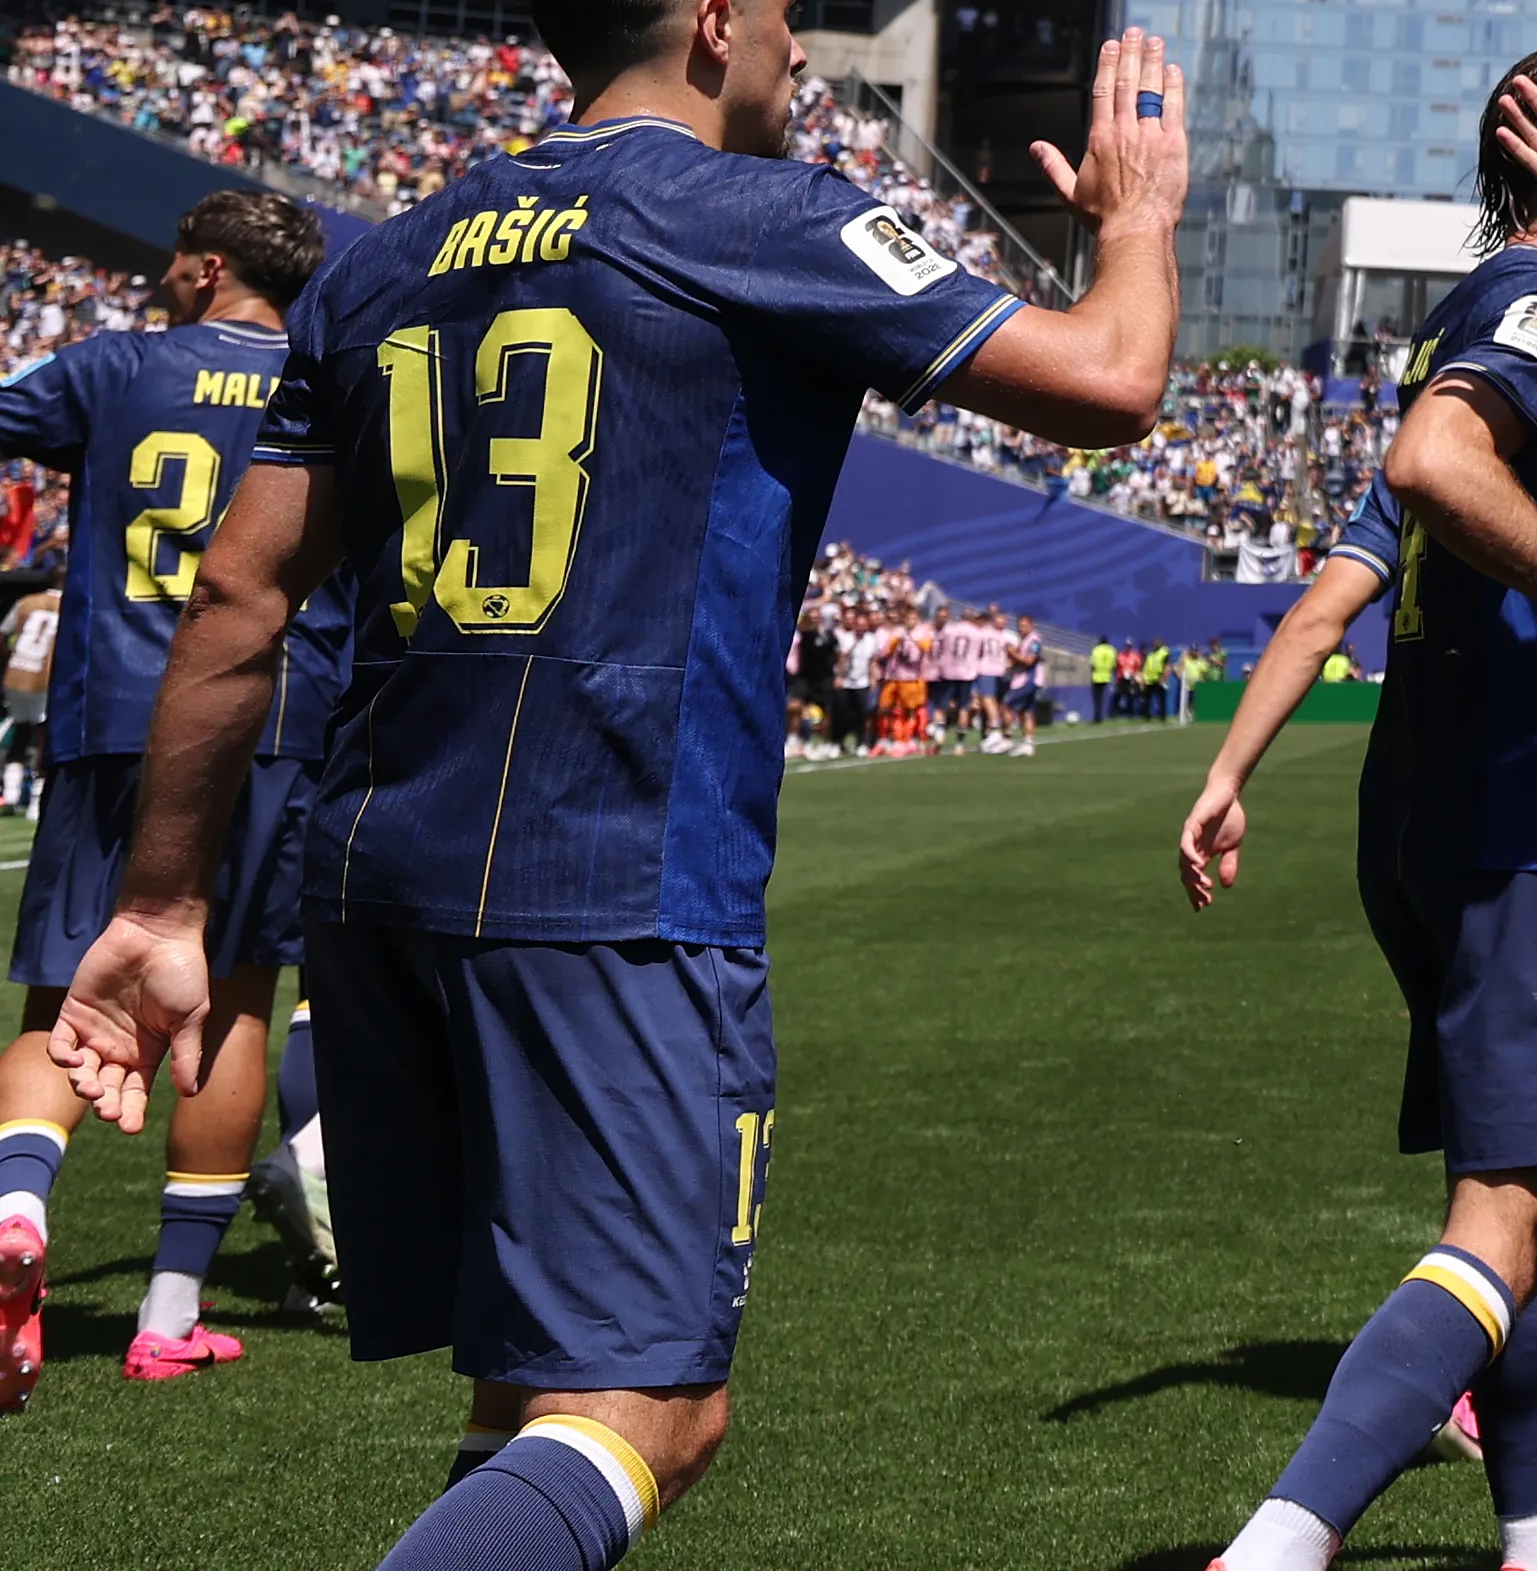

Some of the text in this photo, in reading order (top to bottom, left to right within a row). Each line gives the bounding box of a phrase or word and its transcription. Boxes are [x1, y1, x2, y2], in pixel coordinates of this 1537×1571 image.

[427, 194, 589, 277] BAŠIĆ
[125, 431, 238, 603] 2
[377, 307, 604, 635] 13
